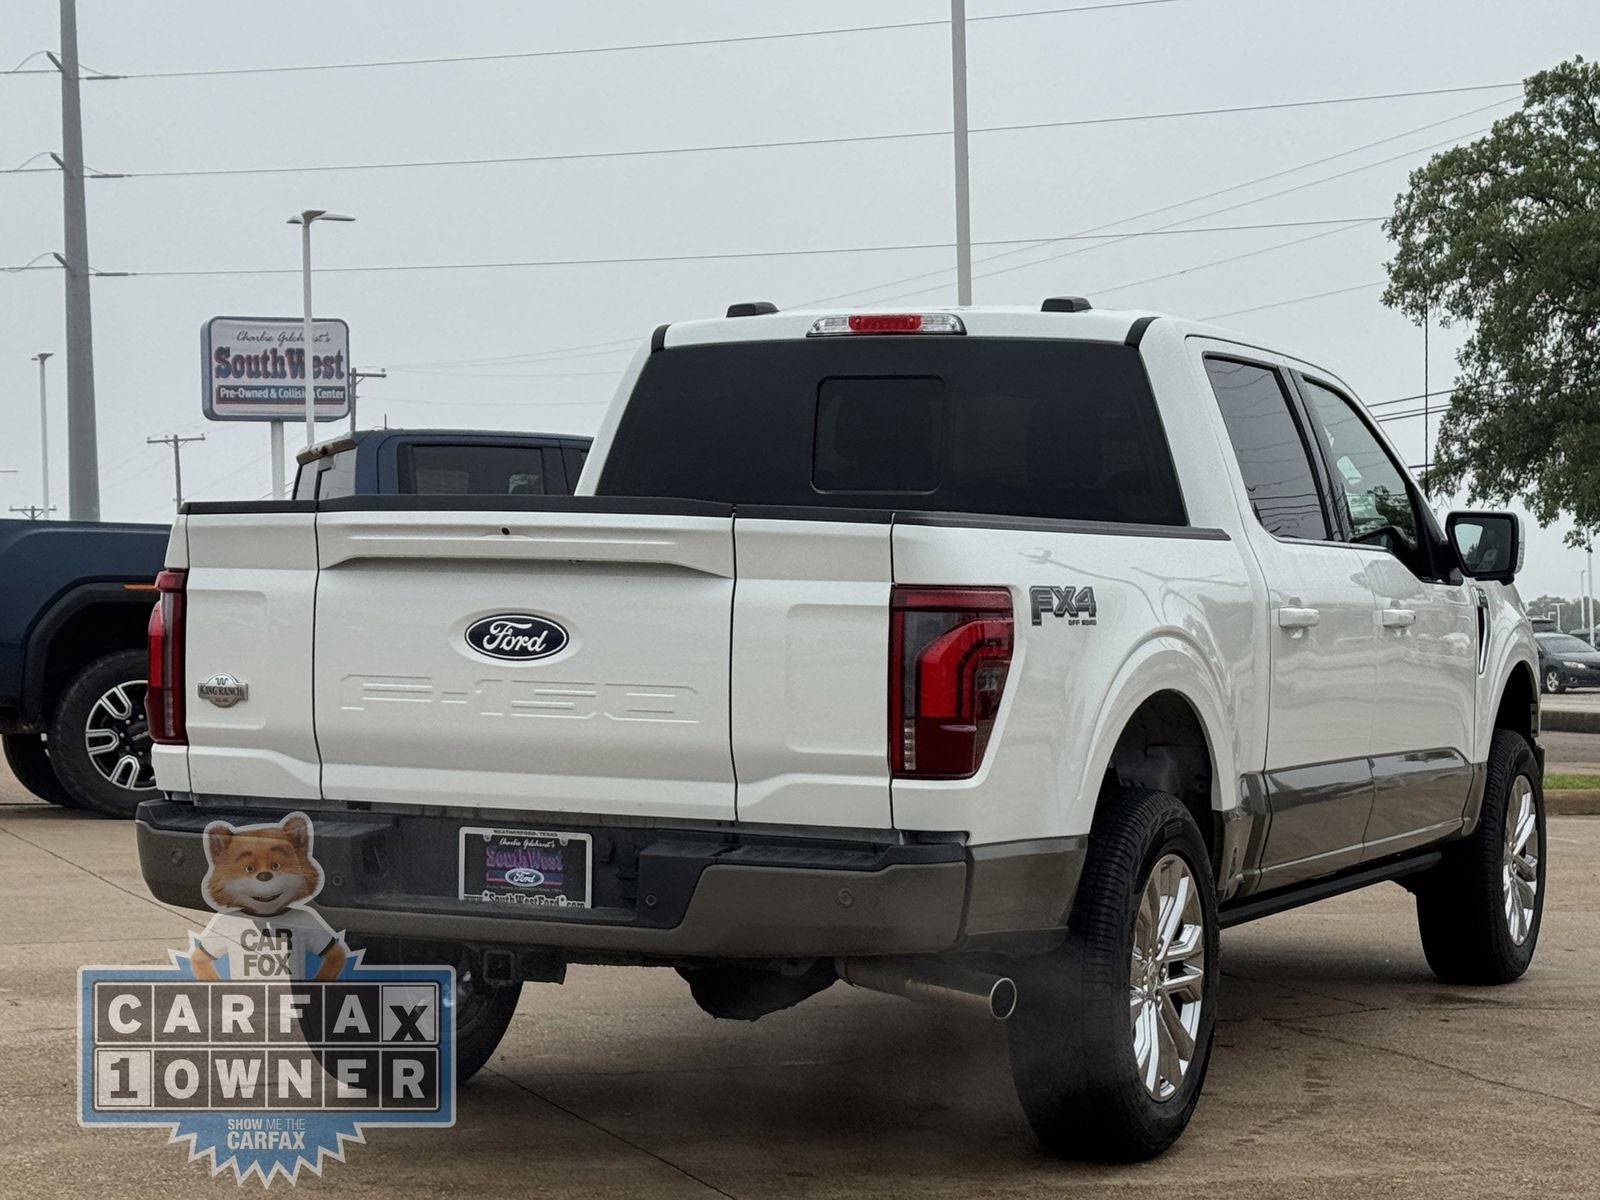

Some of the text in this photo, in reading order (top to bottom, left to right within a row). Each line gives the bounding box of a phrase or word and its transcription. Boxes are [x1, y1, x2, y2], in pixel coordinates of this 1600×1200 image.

[236, 330, 331, 347] Charlie Gilchist's
[215, 346, 345, 380] SouthWest
[220, 387, 345, 400] Pre-Owned & Collisi Center
[1029, 586, 1097, 626] FX4
[482, 621, 548, 652] Ford
[200, 684, 241, 697] KING RANCH
[513, 871, 535, 883] Ford
[488, 892, 586, 909] SouthWestFordcom
